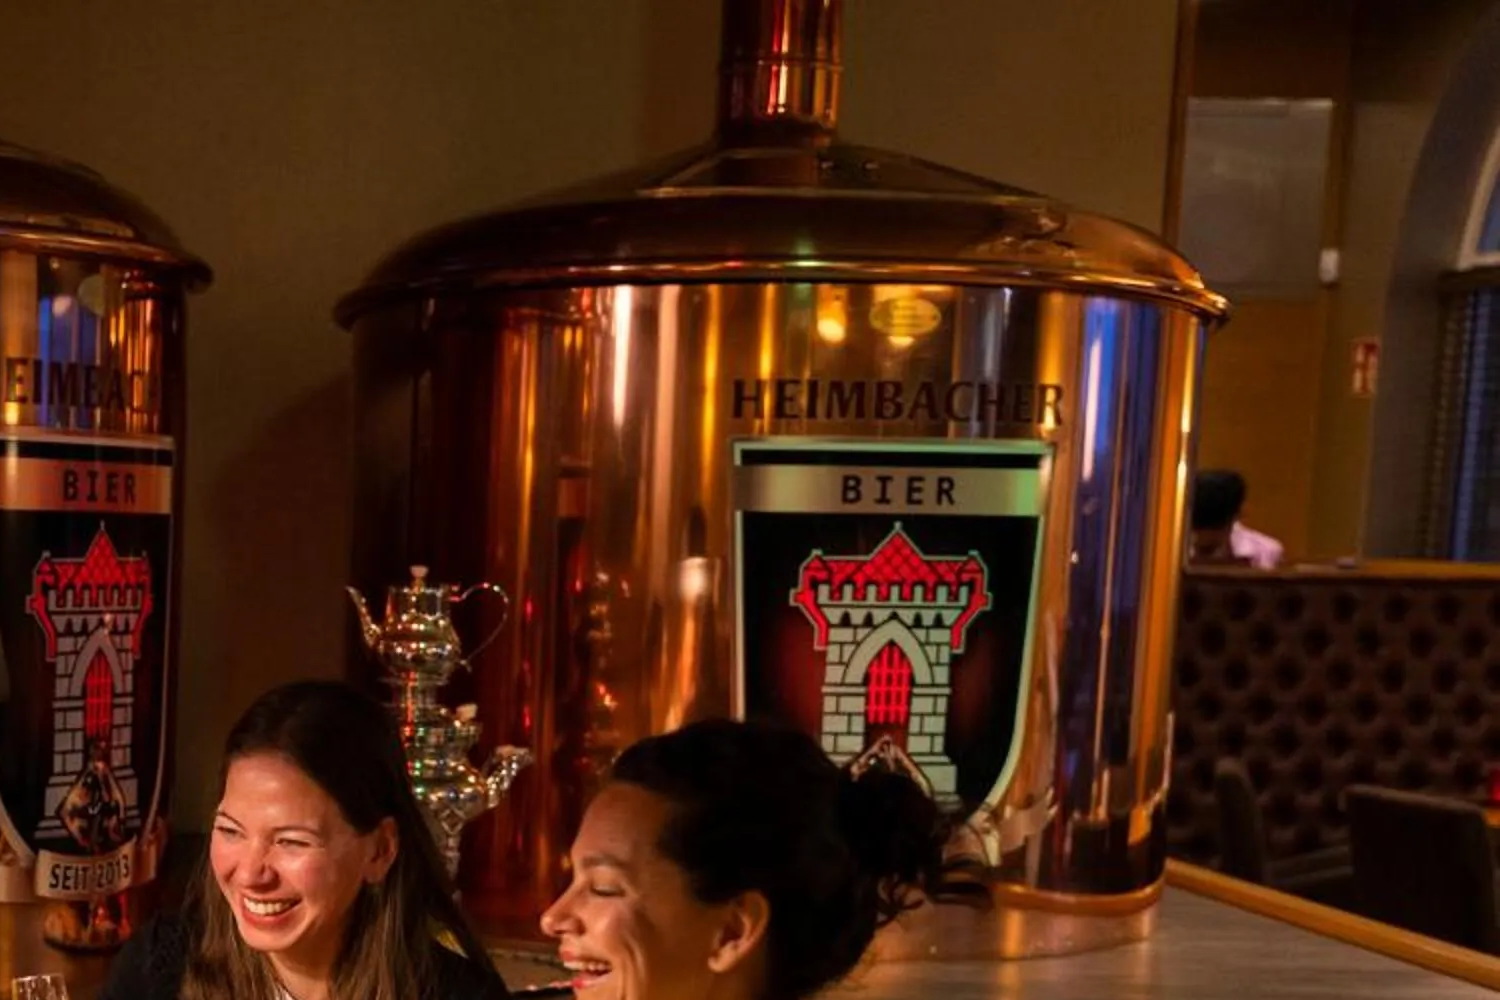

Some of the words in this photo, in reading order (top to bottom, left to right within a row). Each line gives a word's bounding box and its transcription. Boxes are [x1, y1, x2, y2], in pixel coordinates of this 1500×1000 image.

[732, 378, 1063, 425] HEIMBACHER
[62, 469, 137, 503] BIER
[841, 474, 956, 505] BIER
[49, 864, 89, 890] SEIT
[96, 855, 129, 888] 2013
